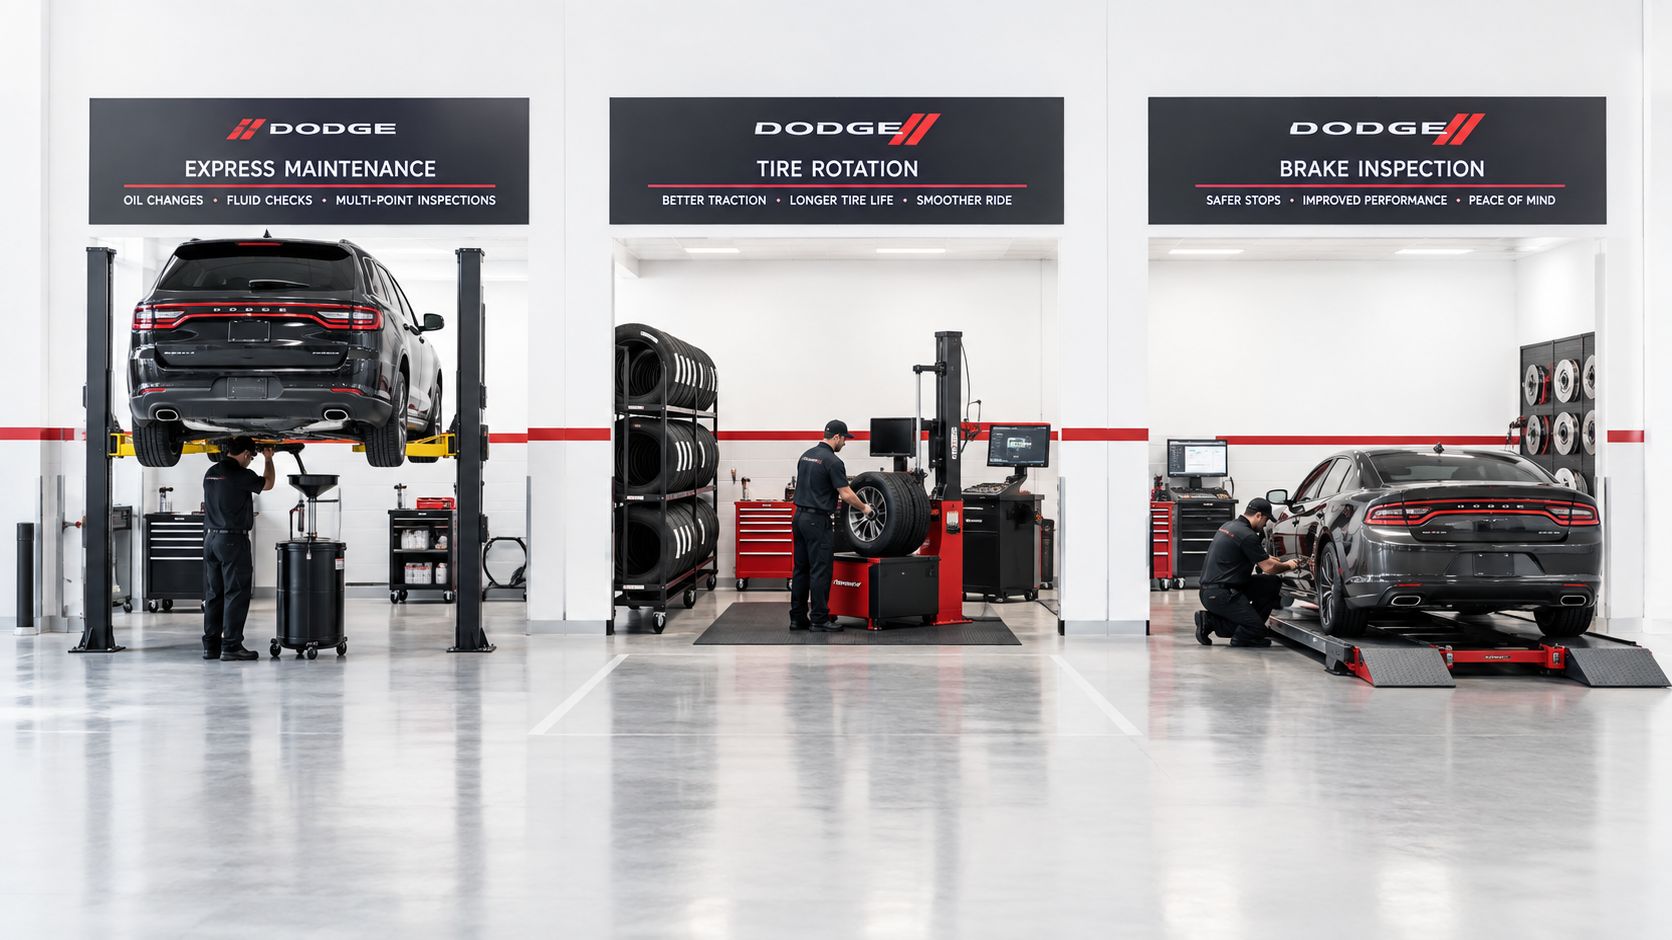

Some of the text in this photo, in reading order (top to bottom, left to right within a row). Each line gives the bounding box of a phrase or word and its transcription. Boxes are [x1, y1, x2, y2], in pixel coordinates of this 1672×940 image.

[269, 122, 397, 135] DODGE
[754, 121, 904, 136] DODGE
[1289, 121, 1448, 136] DODGE
[185, 159, 436, 178] EXPRESS MAINTENANCE
[756, 159, 918, 178] TIRE ROTATION
[1280, 159, 1485, 178] BRAKE INSPECTION
[123, 194, 497, 206] OIL CHANGES FLUID CHECKS MULTI-POINT INSPECTIONS
[662, 194, 1013, 206] BETTER TRACTION LONGER TIRE LIFE SMOOTHER RIDE
[1206, 194, 1556, 206] SAFER STOPS IMPROVED PERFORMANCE PEACE OF MIND
